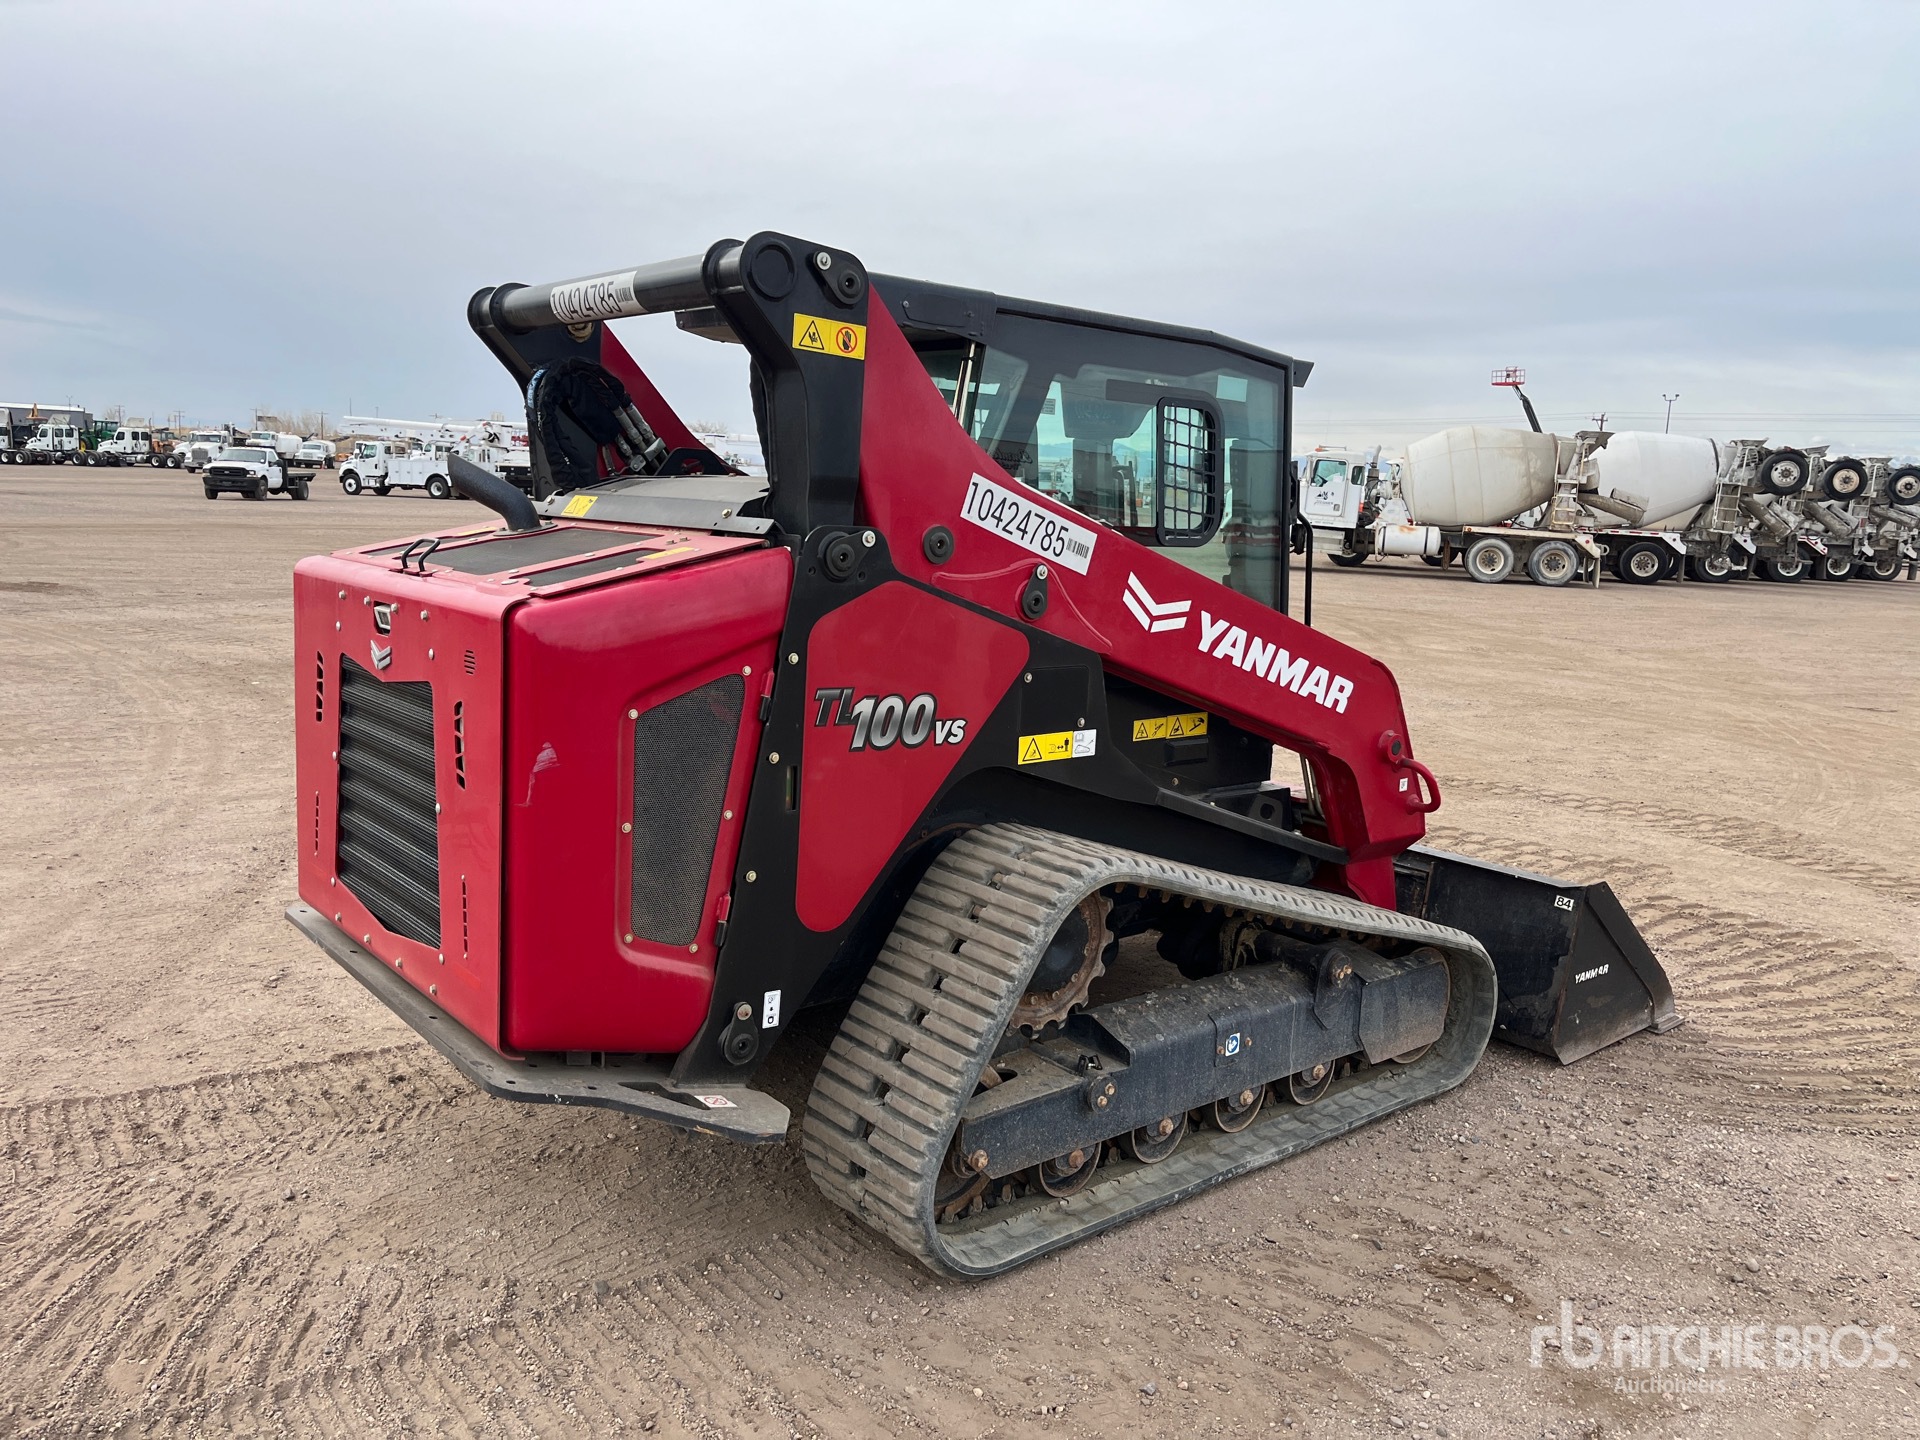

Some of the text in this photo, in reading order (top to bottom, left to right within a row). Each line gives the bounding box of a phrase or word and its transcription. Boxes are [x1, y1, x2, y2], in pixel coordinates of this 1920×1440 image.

[552, 281, 622, 321] 10424785
[967, 482, 1069, 557] 10424785
[1198, 610, 1354, 714] YANMAR
[1557, 897, 1571, 908] 84
[1575, 964, 1609, 984] YANMAR
